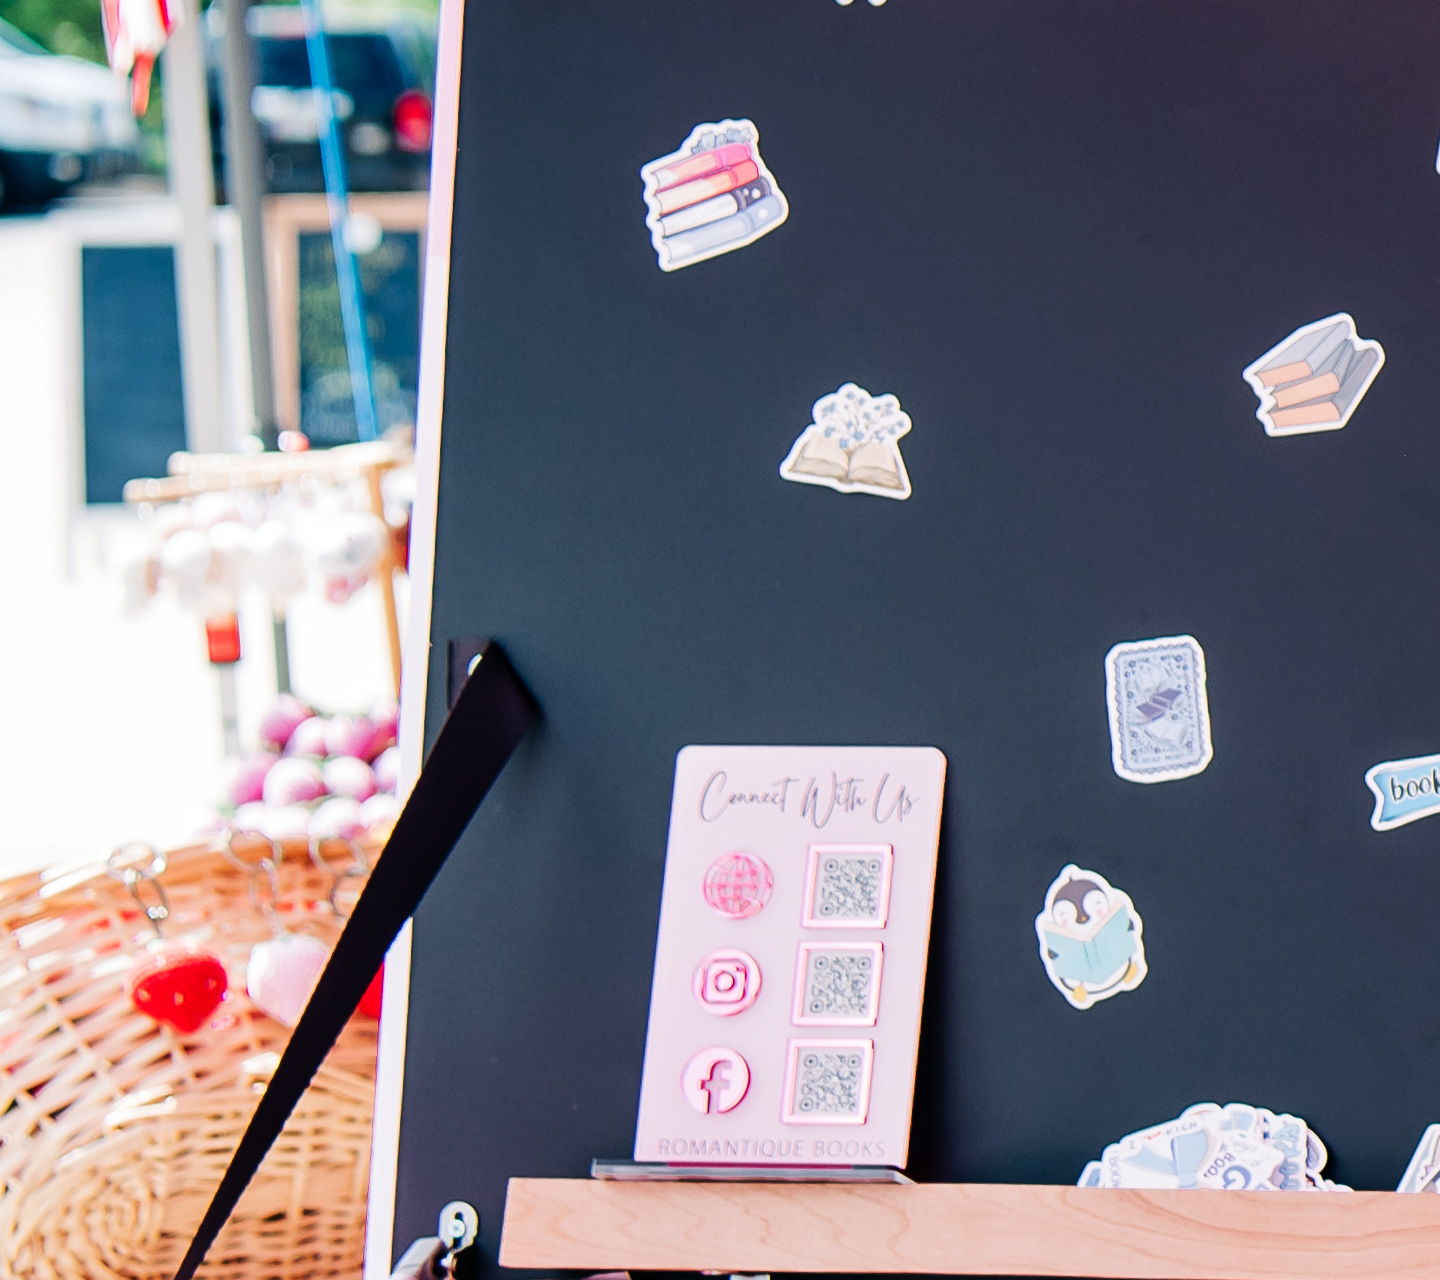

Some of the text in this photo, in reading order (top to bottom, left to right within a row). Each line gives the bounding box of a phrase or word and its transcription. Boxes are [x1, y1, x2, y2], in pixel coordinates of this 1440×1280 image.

[699, 770, 921, 829] Connect With Us
[657, 1137, 886, 1159] ROMANTIQUE BOOKS
